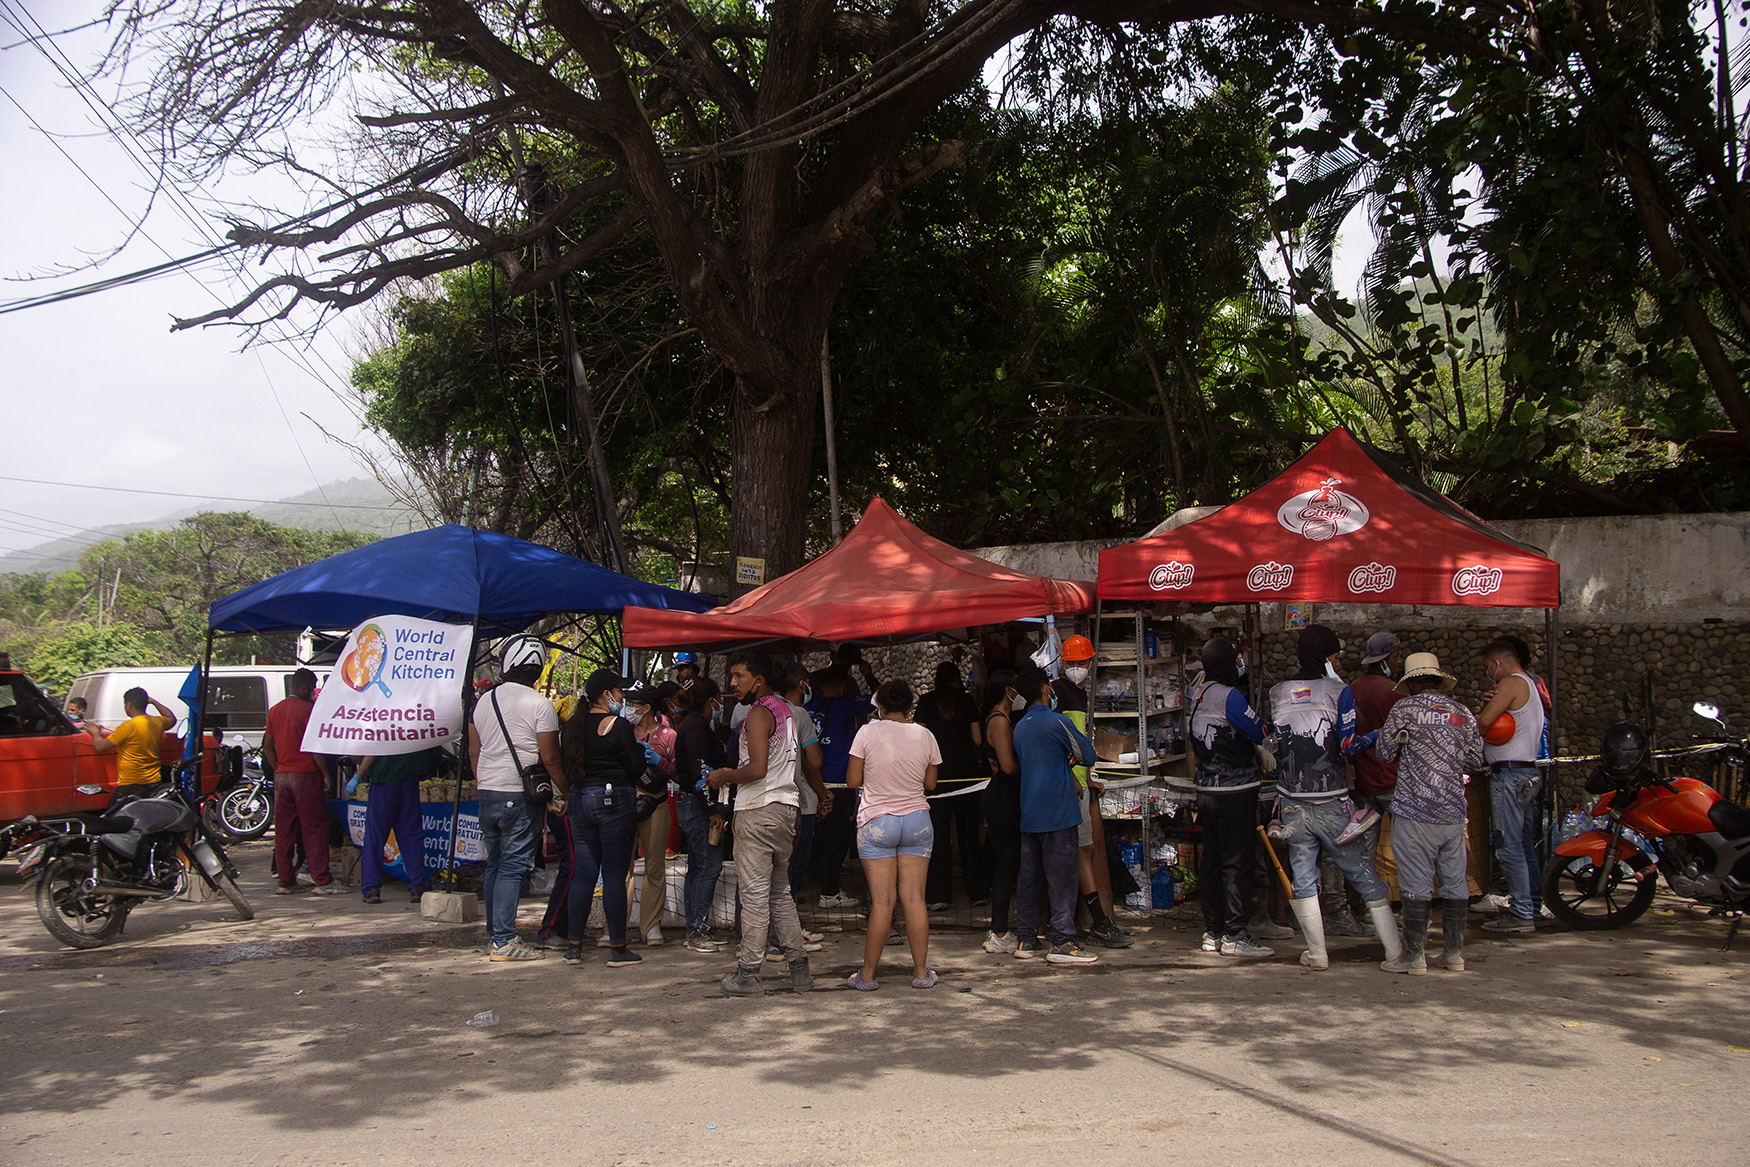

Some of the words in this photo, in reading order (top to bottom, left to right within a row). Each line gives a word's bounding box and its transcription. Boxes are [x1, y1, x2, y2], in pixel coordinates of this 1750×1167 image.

[1151, 565, 1193, 588] Glup!
[1249, 565, 1292, 589] Glup!
[1350, 566, 1394, 591] Glup!
[1455, 568, 1500, 592] Glup!
[395, 628, 445, 645] World
[394, 646, 456, 662] Central
[391, 664, 455, 680] Kitchen
[331, 703, 436, 722] Asistencia
[318, 723, 450, 741] Humanitaria
[353, 810, 366, 819] COM
[350, 819, 366, 828] GRAT
[459, 818, 481, 831] COMID
[456, 829, 484, 841] RATUIT
[423, 836, 450, 851] entr
[423, 853, 461, 869] tchen
